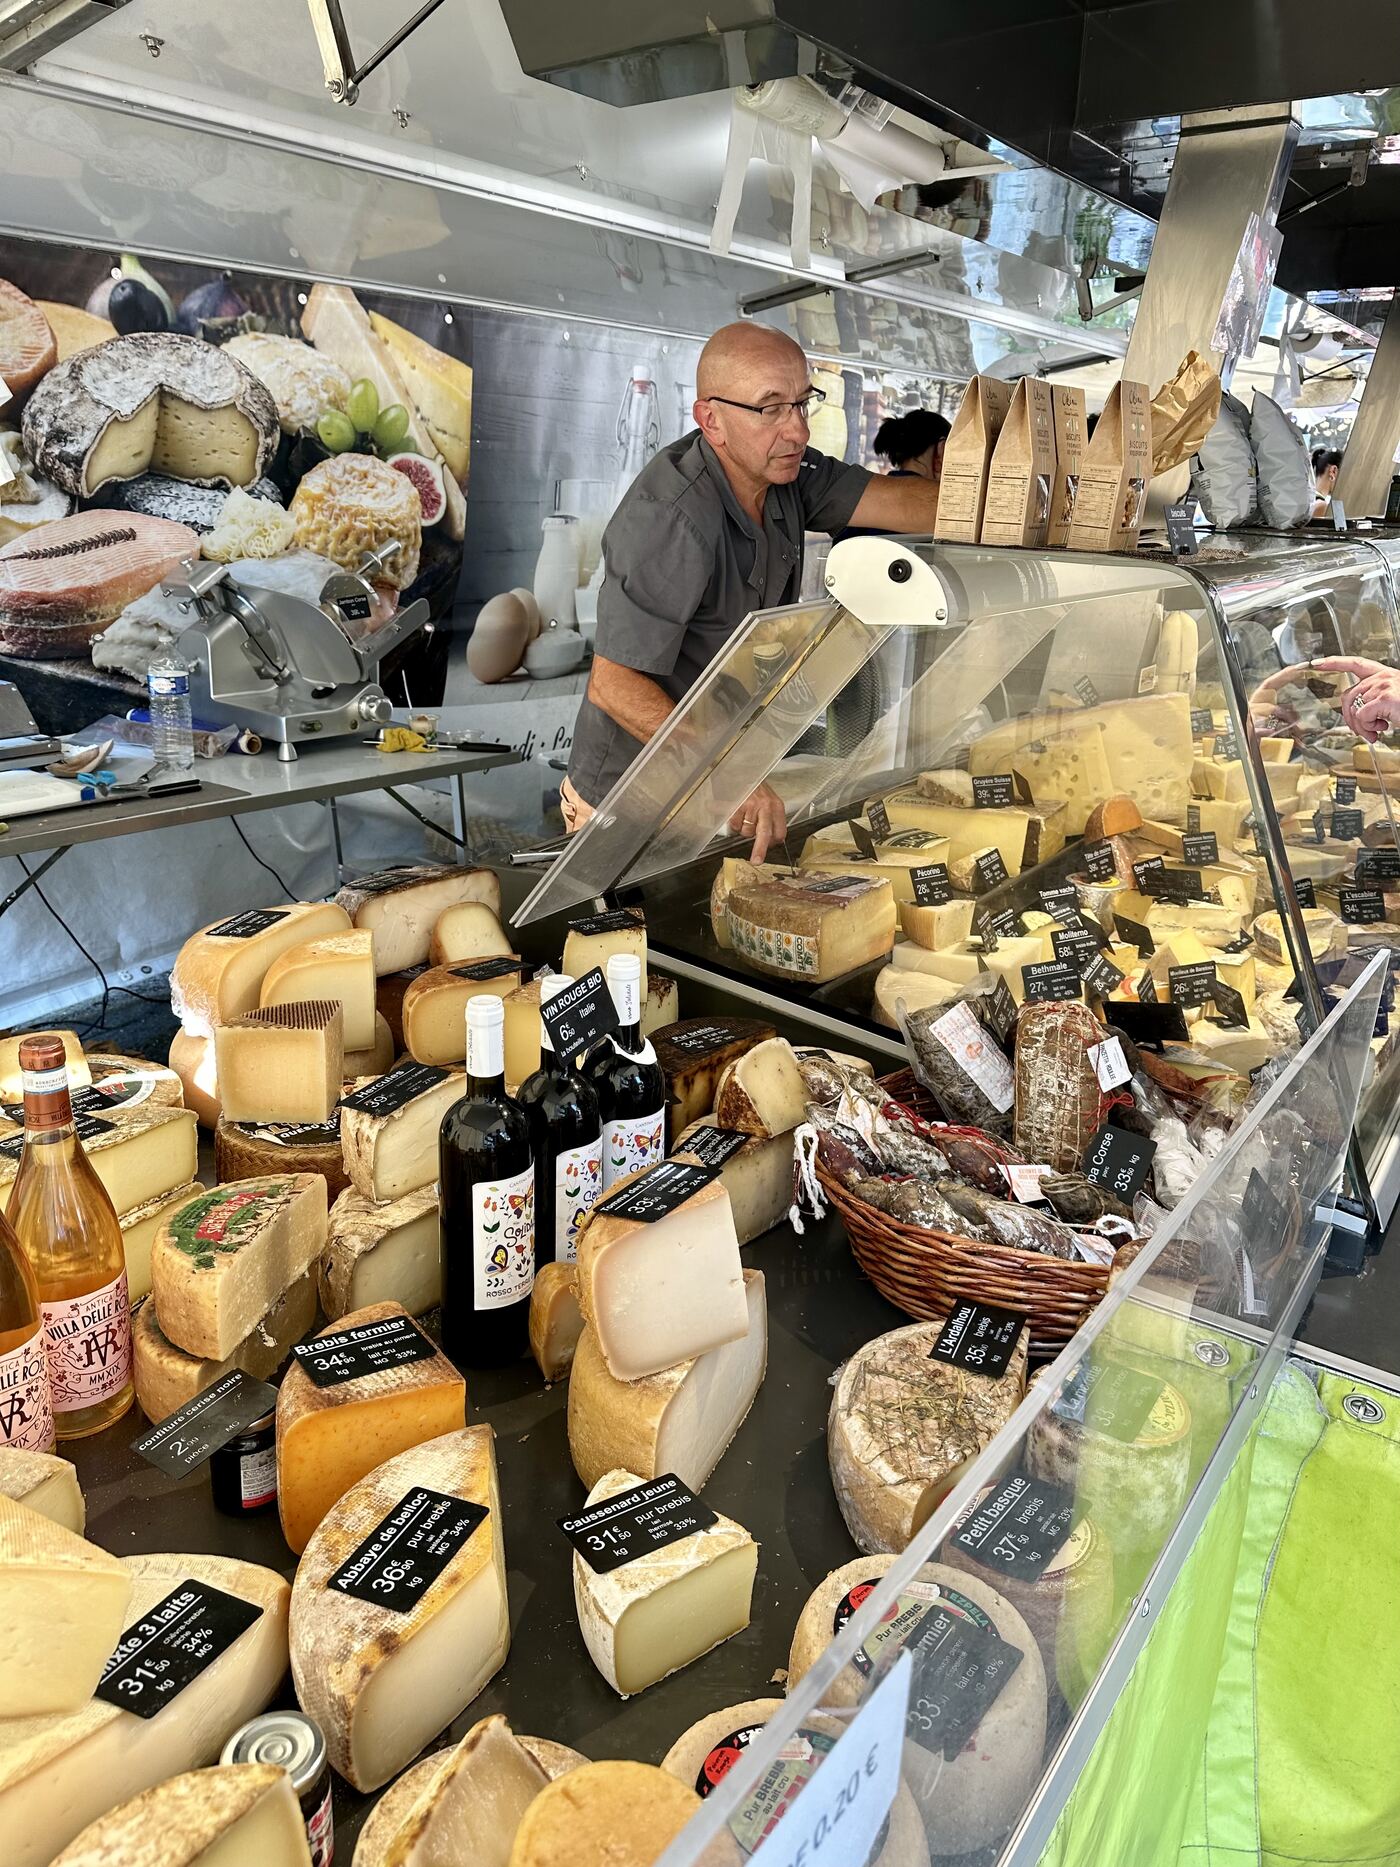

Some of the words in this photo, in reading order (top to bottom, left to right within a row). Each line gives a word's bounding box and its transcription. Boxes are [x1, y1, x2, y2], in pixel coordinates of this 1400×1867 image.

[1039, 890, 1058, 898] Tomme
[1058, 929, 1088, 940] Moliterno
[1031, 962, 1068, 975] Bethmale
[542, 1007, 559, 1021] VIN
[557, 984, 588, 1010] ROUGE
[586, 972, 602, 990] BIO
[578, 1002, 596, 1019] Italie
[354, 1069, 405, 1099] Hercules
[280, 1124, 320, 1138] QUESO
[1092, 1132, 1114, 1165] Corse
[1129, 1154, 1140, 1165] kg
[600, 1192, 631, 1213] Tomme
[630, 1183, 643, 1194] des
[643, 1163, 674, 1186] Pyrénées
[85, 1295, 114, 1312] ANTICA
[486, 1287, 512, 1298] ROSSO
[46, 1320, 81, 1342] VILLA
[81, 1306, 113, 1329] DELLE
[937, 1306, 972, 1355] L'Ardalhou
[973, 1316, 993, 1338] brebis
[293, 1335, 349, 1356] Brebis
[350, 1319, 405, 1340] fermier
[360, 1341, 383, 1351] brebis
[393, 1332, 417, 1343] piment
[368, 1350, 382, 1360] lait
[382, 1347, 396, 1356] cru
[373, 1357, 389, 1366] MG
[395, 1349, 417, 1360] 33%
[89, 1362, 121, 1386] MMXIX
[335, 1367, 350, 1376] kg
[138, 1416, 185, 1452] confiture
[186, 1392, 216, 1416] cerise
[216, 1373, 242, 1394] noire
[225, 1420, 240, 1433] MG
[563, 1492, 642, 1531] Caussenard
[640, 1479, 677, 1502] jeune
[634, 1511, 654, 1526] pur
[657, 1494, 692, 1515] brebis
[959, 1515, 993, 1547] Petit
[989, 1476, 1026, 1518] basque
[1015, 1496, 1044, 1525] brebis
[406, 1529, 426, 1549] pur
[420, 1500, 451, 1530] brebis
[648, 1519, 674, 1534] thermisé
[650, 1518, 661, 1526] lait
[651, 1529, 668, 1541] MG
[673, 1517, 697, 1531] 33%
[1047, 1524, 1061, 1537] MG
[1058, 1506, 1075, 1523] 33%
[337, 1543, 382, 1590] Abbaye
[379, 1527, 397, 1543] de
[390, 1491, 428, 1526] belloc
[434, 1541, 450, 1556] MG
[450, 1518, 470, 1537] 34%
[613, 1546, 629, 1557] kg
[1026, 1550, 1042, 1562] kg
[405, 1575, 423, 1588] kg
[138, 1623, 157, 1636] 3
[152, 1591, 196, 1624] laits
[949, 1592, 989, 1627] EZPELA
[163, 1605, 207, 1645] chèvre-brebis-
[875, 1626, 893, 1643] Pur
[891, 1602, 923, 1631] BREBIS
[171, 1629, 193, 1648] vache
[181, 1628, 213, 1653] 34%
[194, 1643, 214, 1658] MG
[155, 1678, 175, 1692] kg
[956, 1673, 969, 1690] lait
[967, 1663, 979, 1678] cru
[864, 1741, 879, 1777] €
[743, 1801, 761, 1821] Pur
[755, 1759, 786, 1802] BREBIS
[762, 1801, 773, 1815] au
[769, 1787, 781, 1803] lait
[778, 1775, 790, 1790] cru
